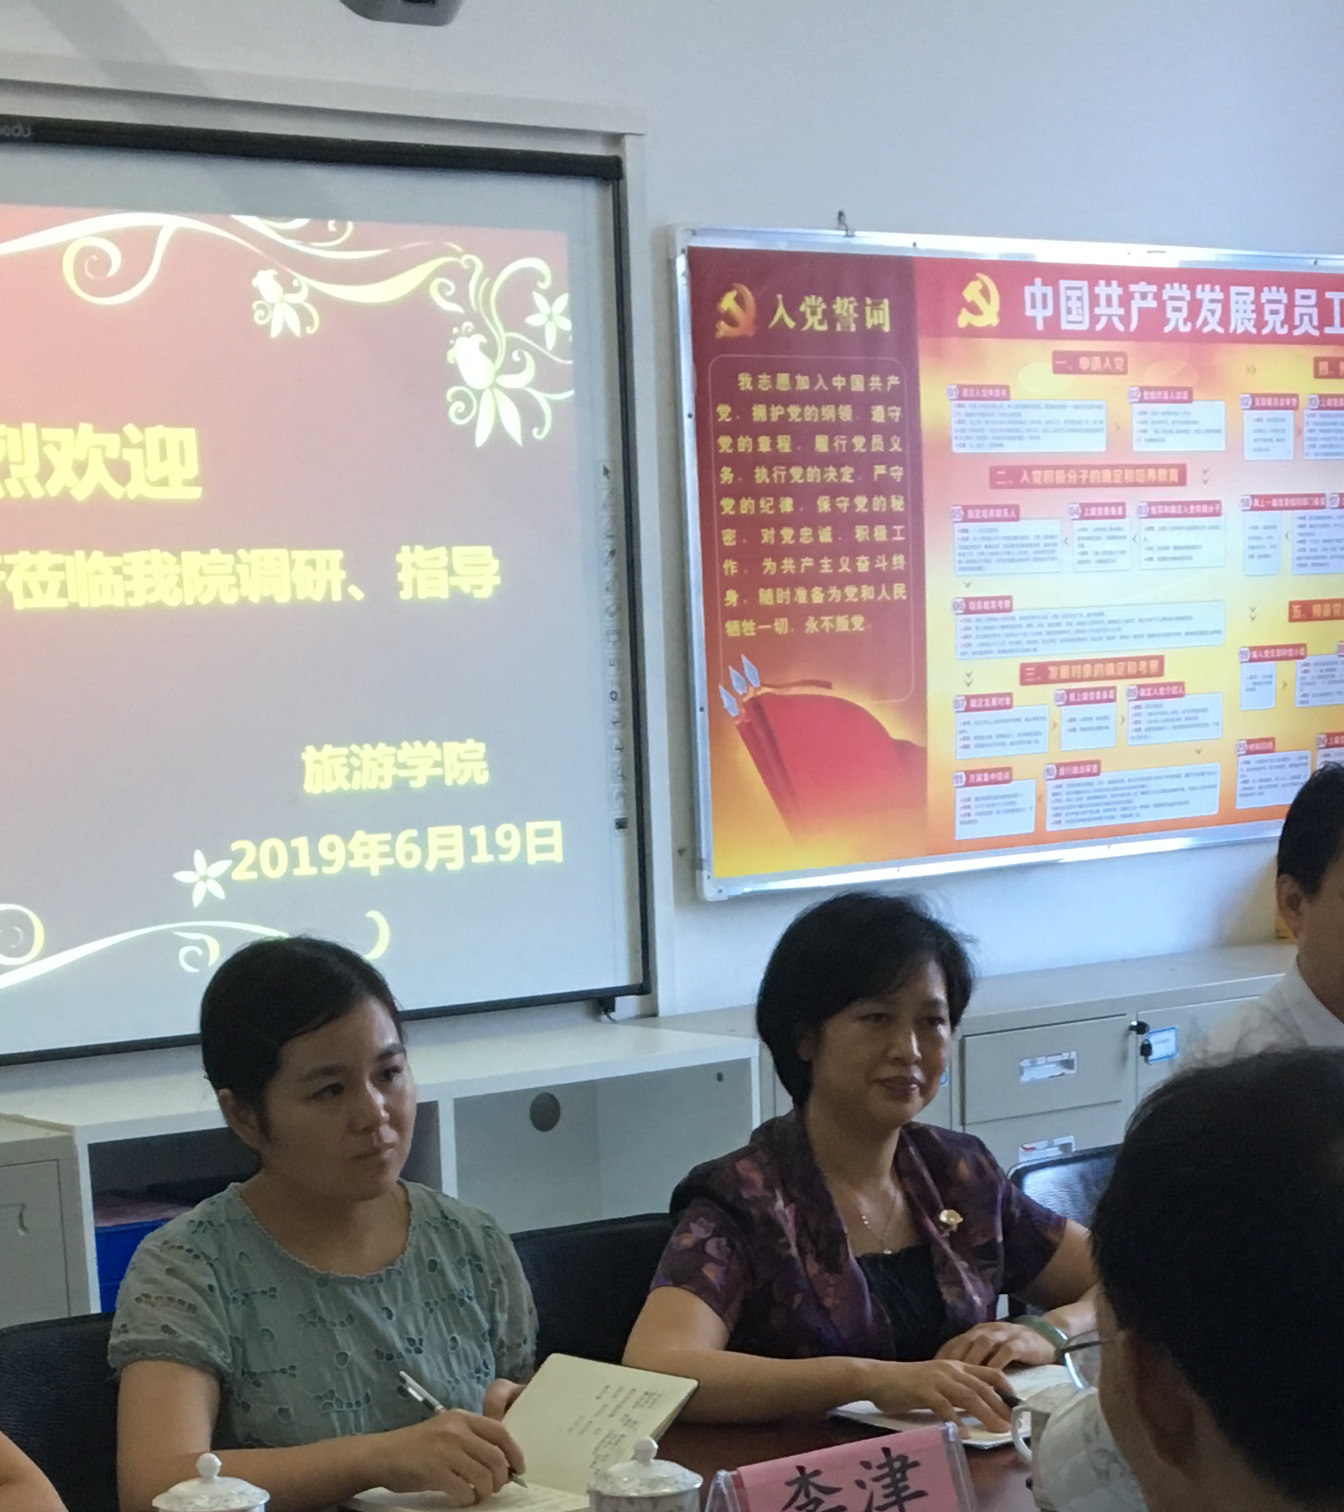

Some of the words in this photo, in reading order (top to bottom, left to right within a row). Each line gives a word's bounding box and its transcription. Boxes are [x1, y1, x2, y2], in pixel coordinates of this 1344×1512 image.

[768, 293, 892, 333] 入党誓词
[737, 372, 901, 392] 我志愿加入中国共产
[301, 738, 490, 794] 旅游学院
[230, 820, 565, 881] 2019年6月19日
